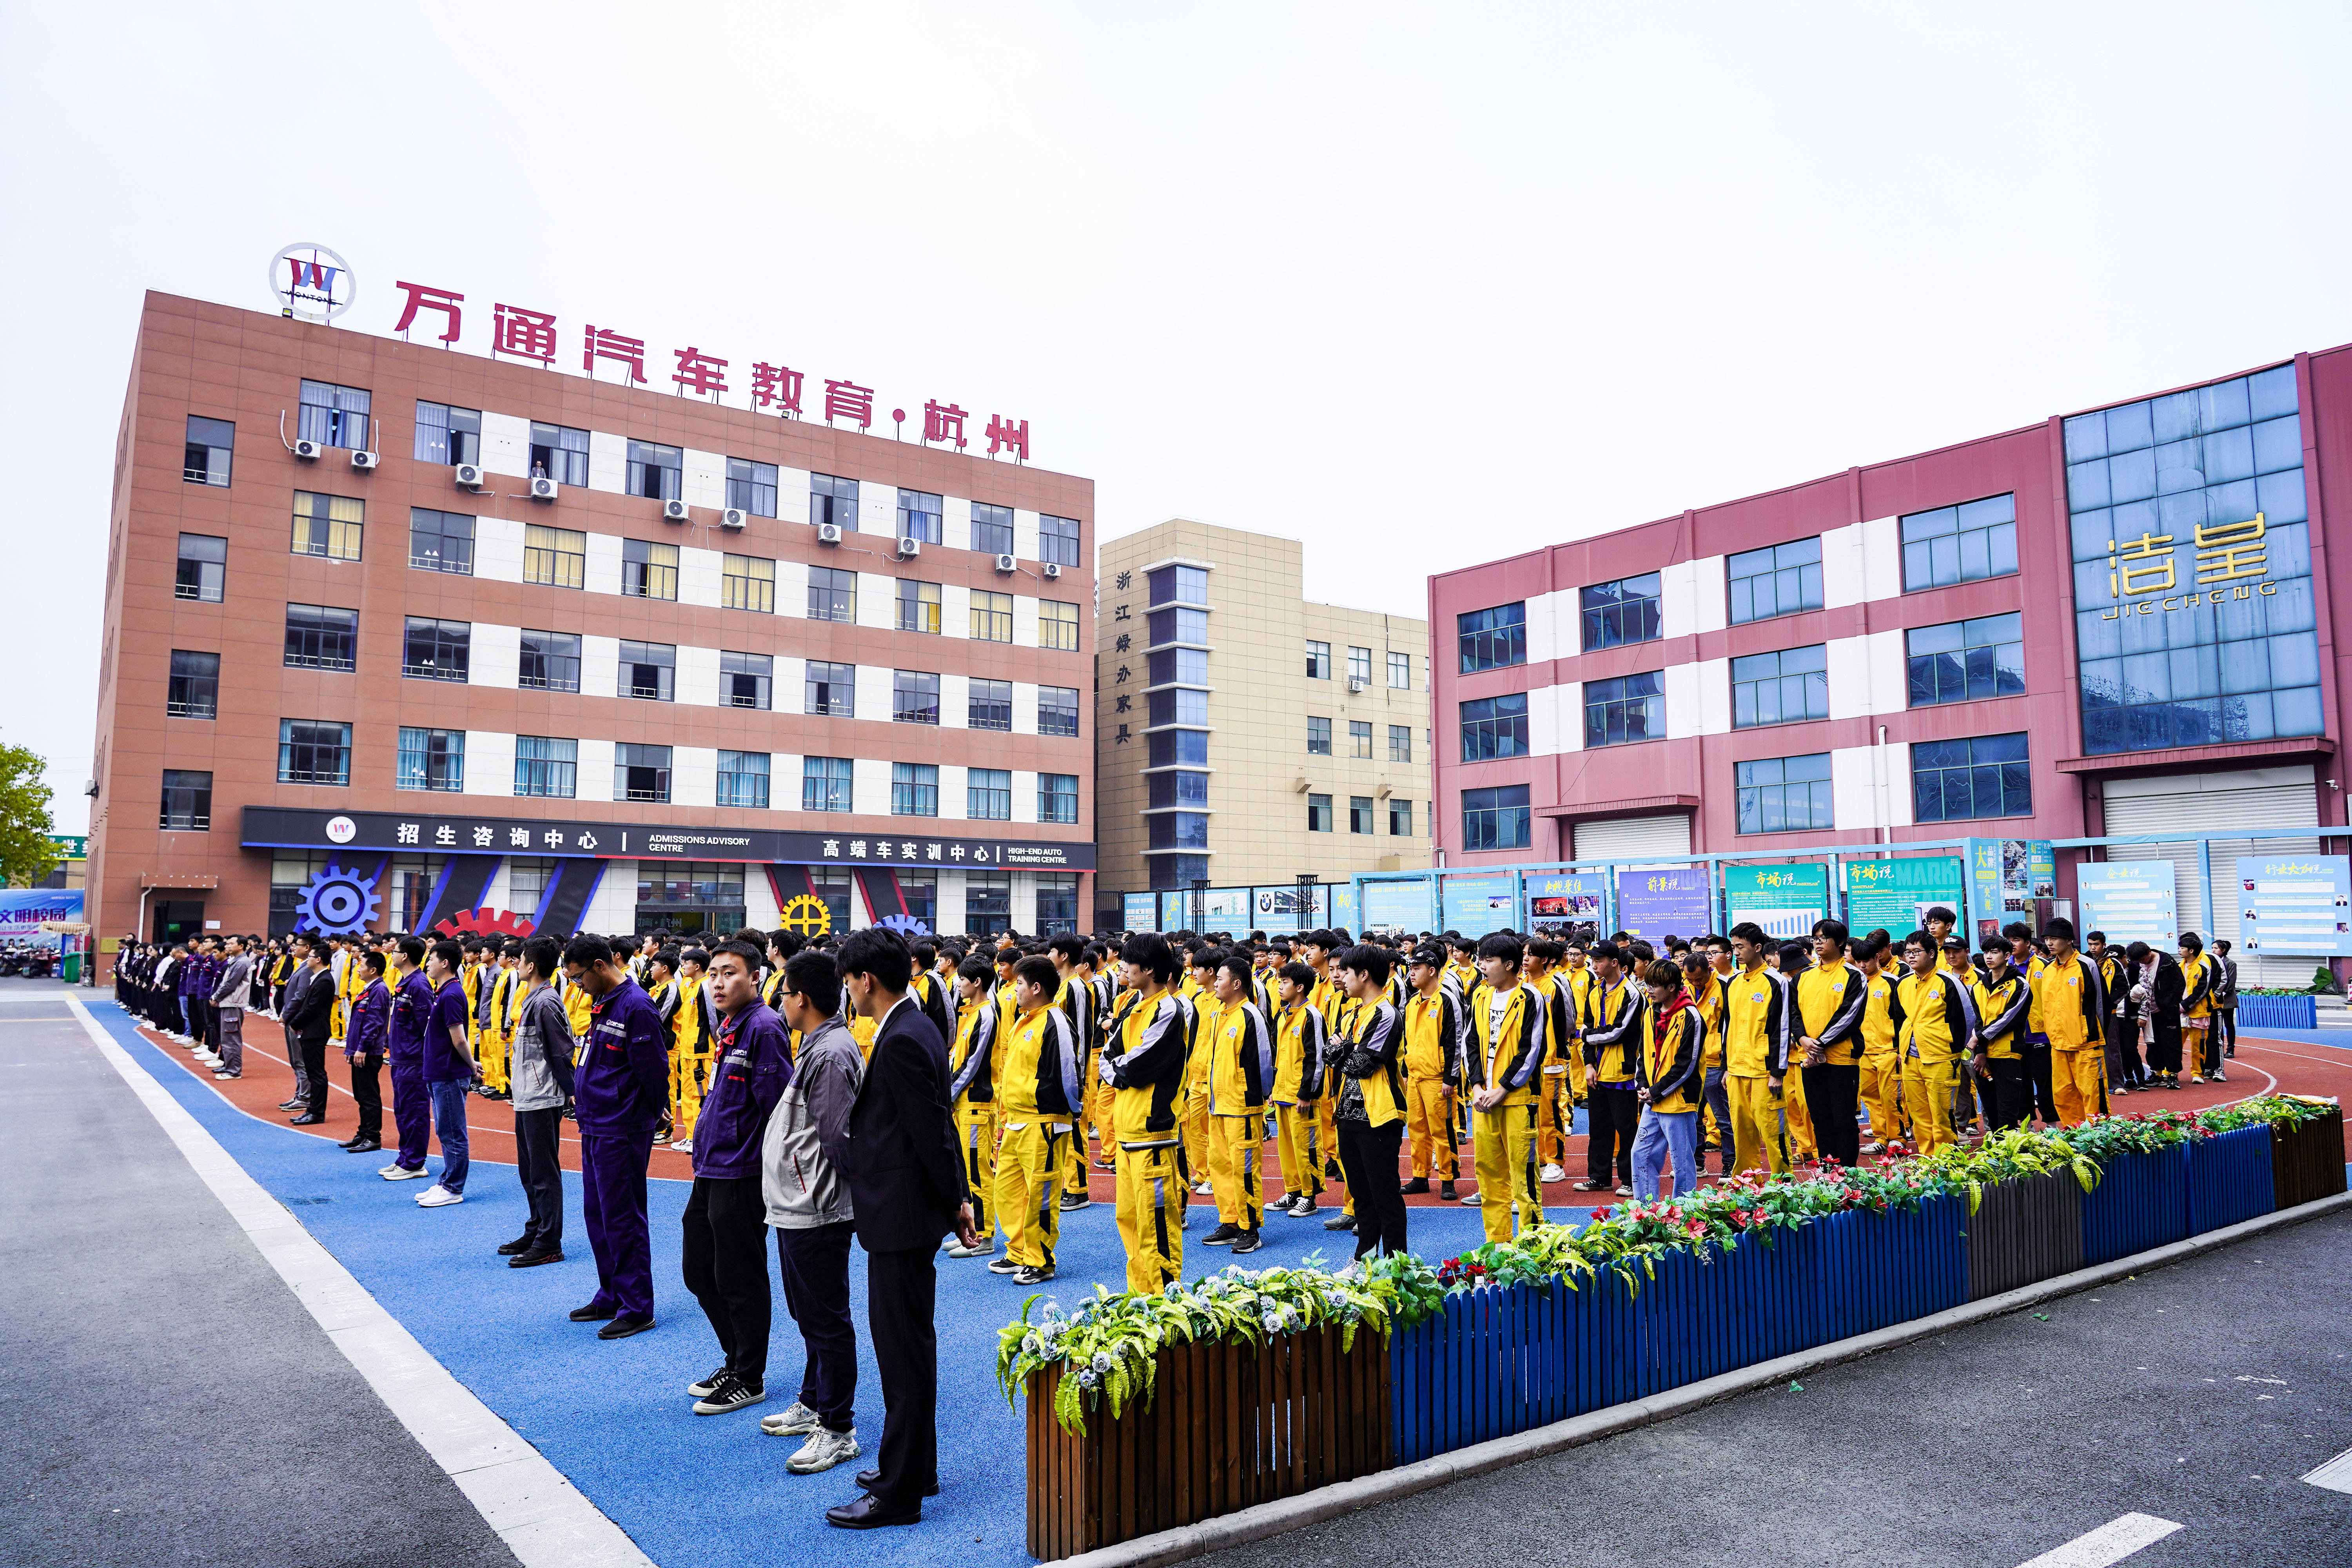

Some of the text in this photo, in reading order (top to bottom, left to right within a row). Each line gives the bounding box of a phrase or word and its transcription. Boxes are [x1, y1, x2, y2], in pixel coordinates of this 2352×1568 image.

[394, 281, 1029, 460] 万通汽车教育·杭州
[2102, 581, 2276, 620] JIECHENG
[1115, 570, 1132, 744] 浙江绿办家具
[397, 822, 598, 850] 招生咨询中心
[649, 835, 750, 846] ADMISSIONS ADVISORY
[649, 844, 683, 853] CENTRE
[823, 840, 989, 862] 高端车实训中心
[1008, 847, 1062, 856] HIGH-END AUTO
[1755, 871, 1797, 889] 市场说
[1849, 864, 1895, 882] 市场说
[1646, 877, 1681, 893] 前景说
